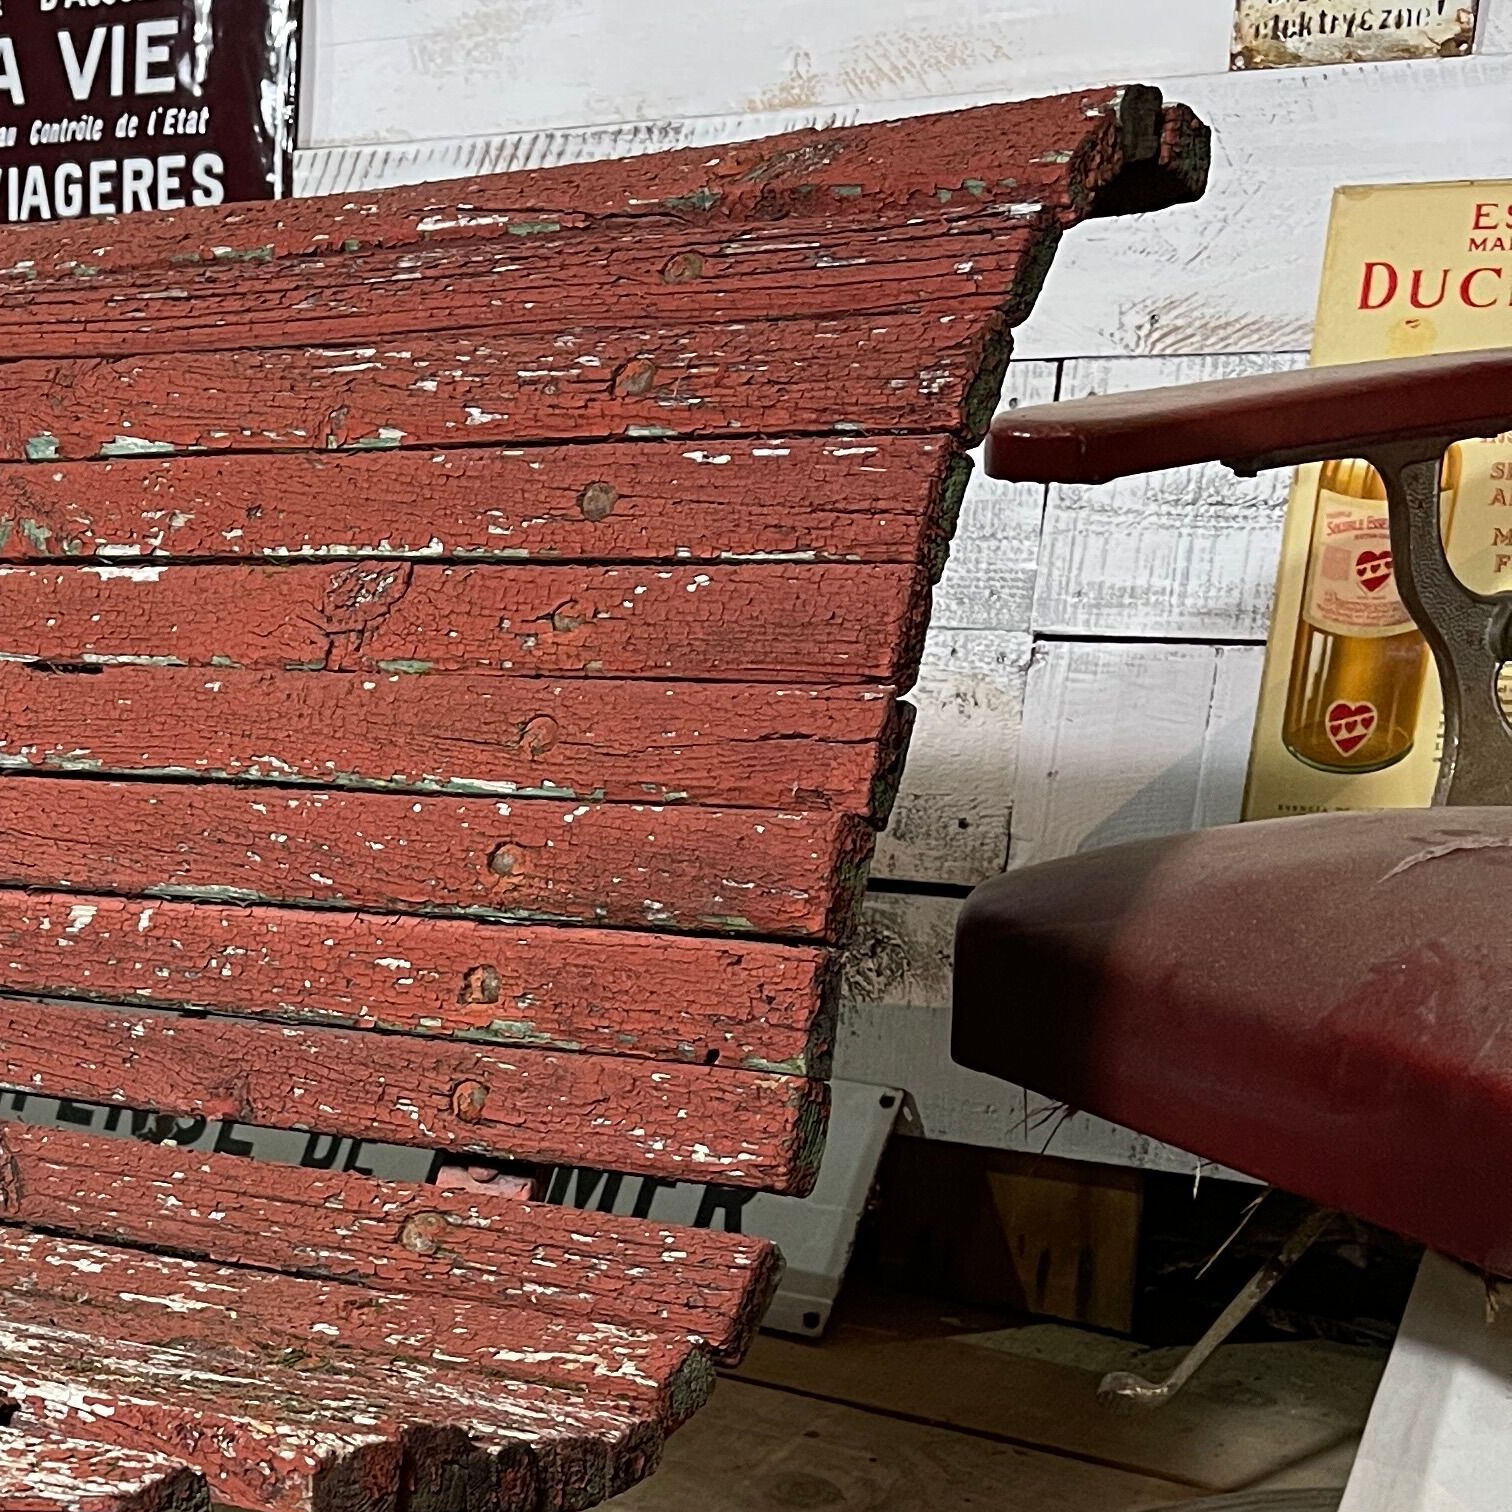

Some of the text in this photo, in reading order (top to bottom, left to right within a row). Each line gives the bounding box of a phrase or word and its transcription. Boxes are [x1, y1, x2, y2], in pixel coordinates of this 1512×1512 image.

[57, 19, 179, 100] VIE
[29, 114, 104, 146] Contrôle
[115, 112, 139, 138] de
[146, 106, 210, 136] l'Etat
[1468, 237, 1512, 252] MA
[1358, 261, 1512, 310] DUC
